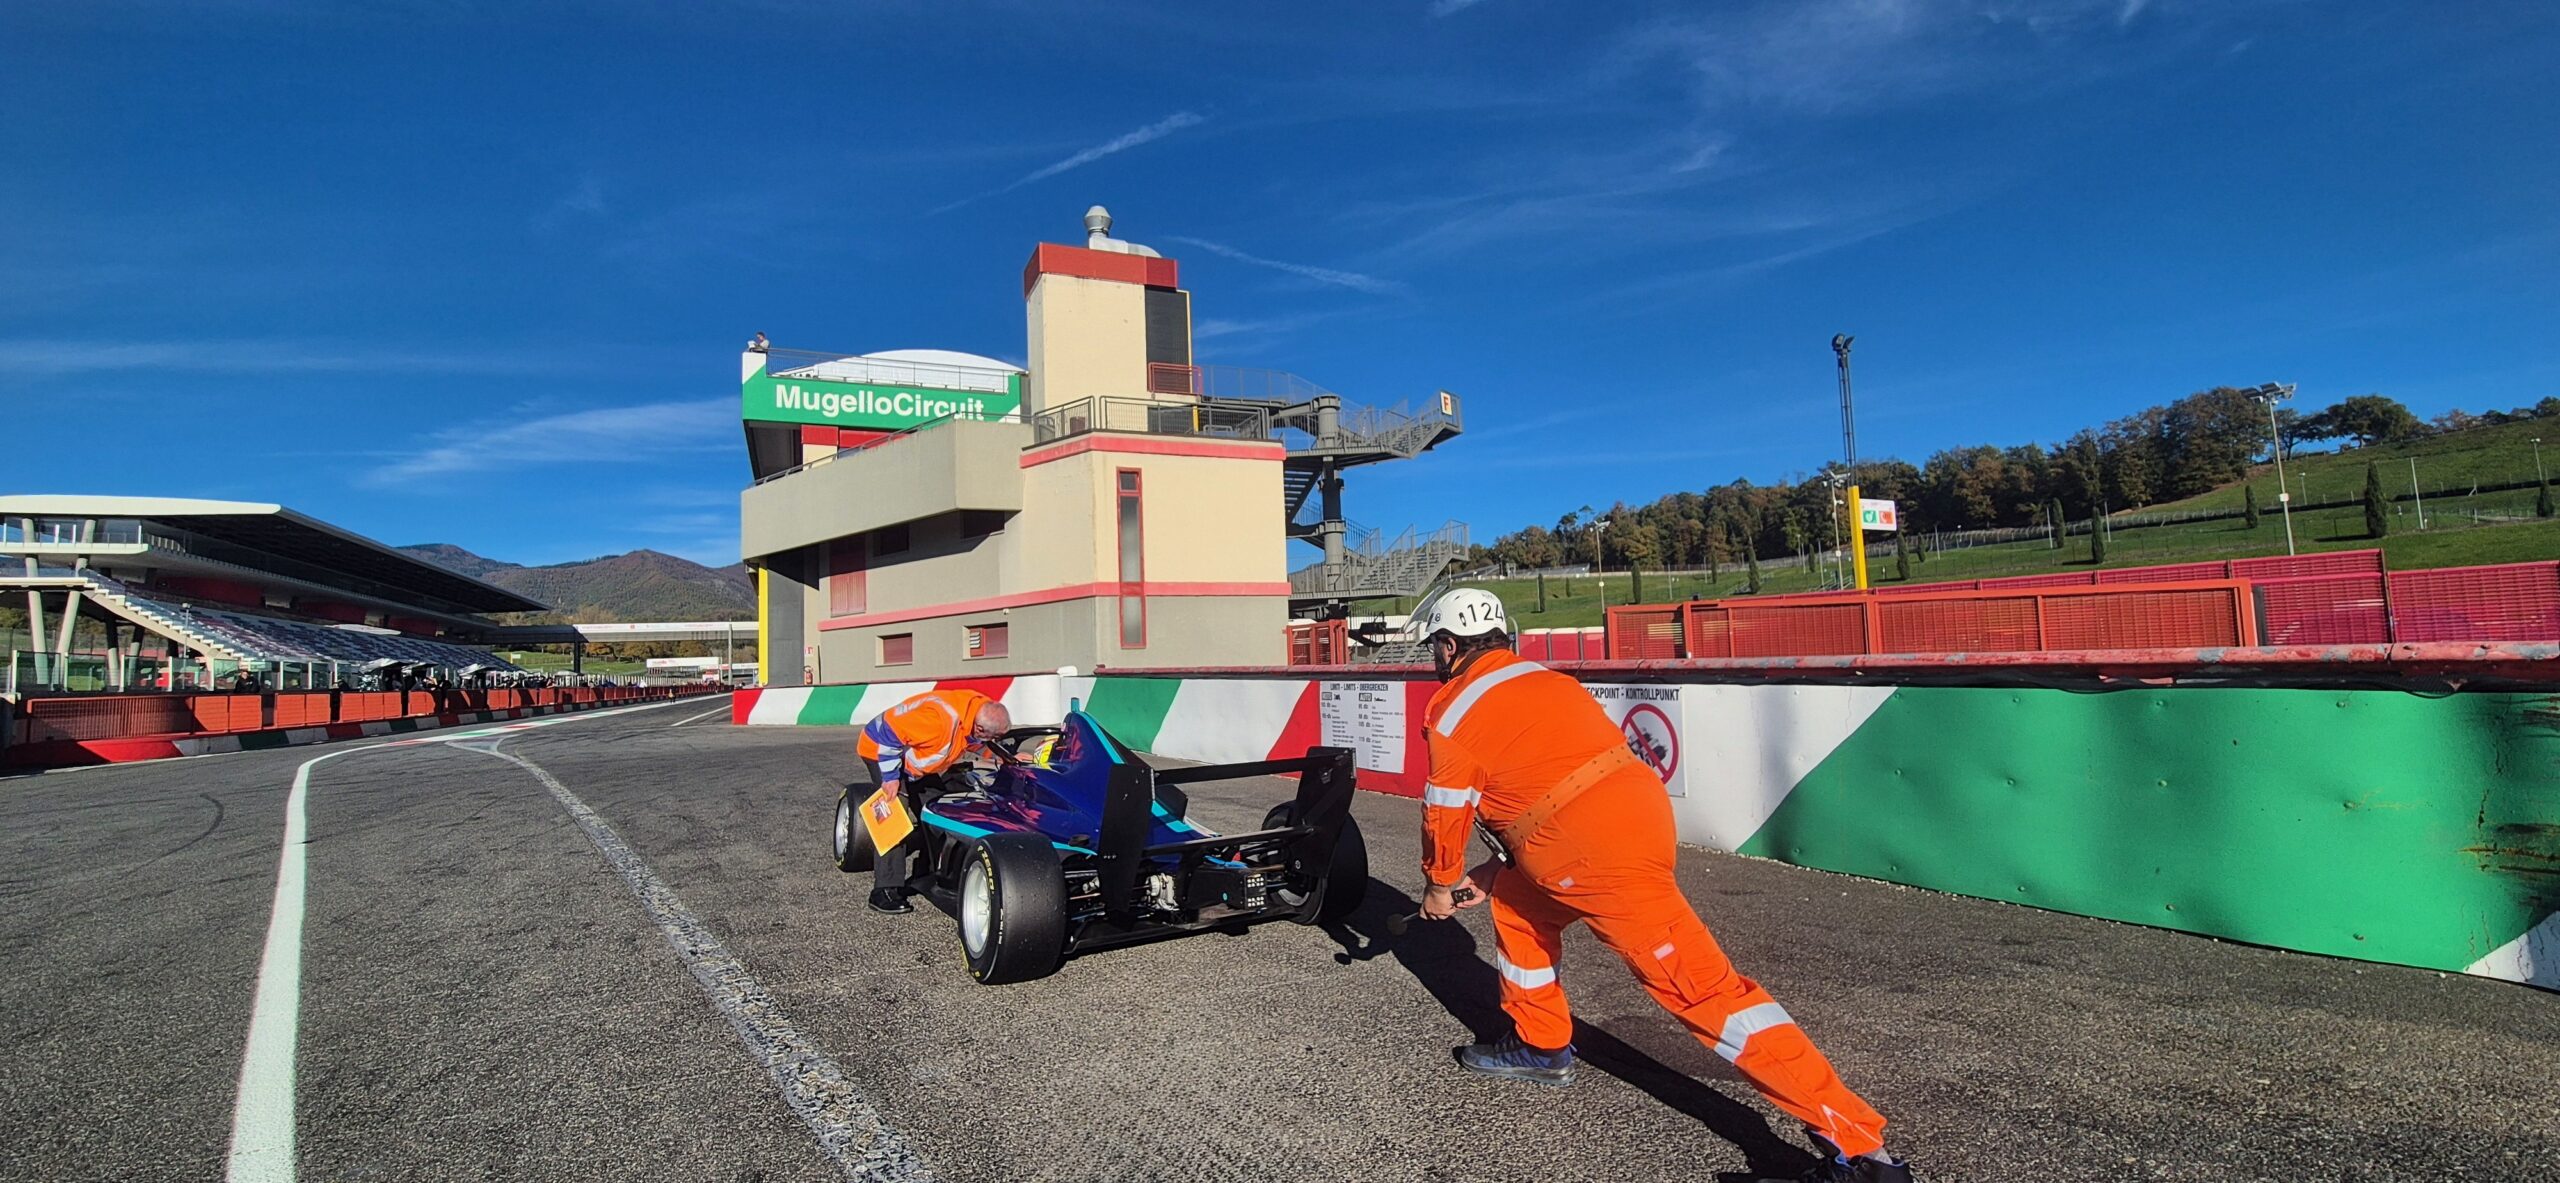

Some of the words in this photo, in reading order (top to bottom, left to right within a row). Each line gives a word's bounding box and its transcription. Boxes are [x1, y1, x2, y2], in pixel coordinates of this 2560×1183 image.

[775, 384, 984, 421] MugelloCircuit
[1467, 602, 1504, 622] 124
[1625, 687, 1680, 701] KONTROLLPUNKT
